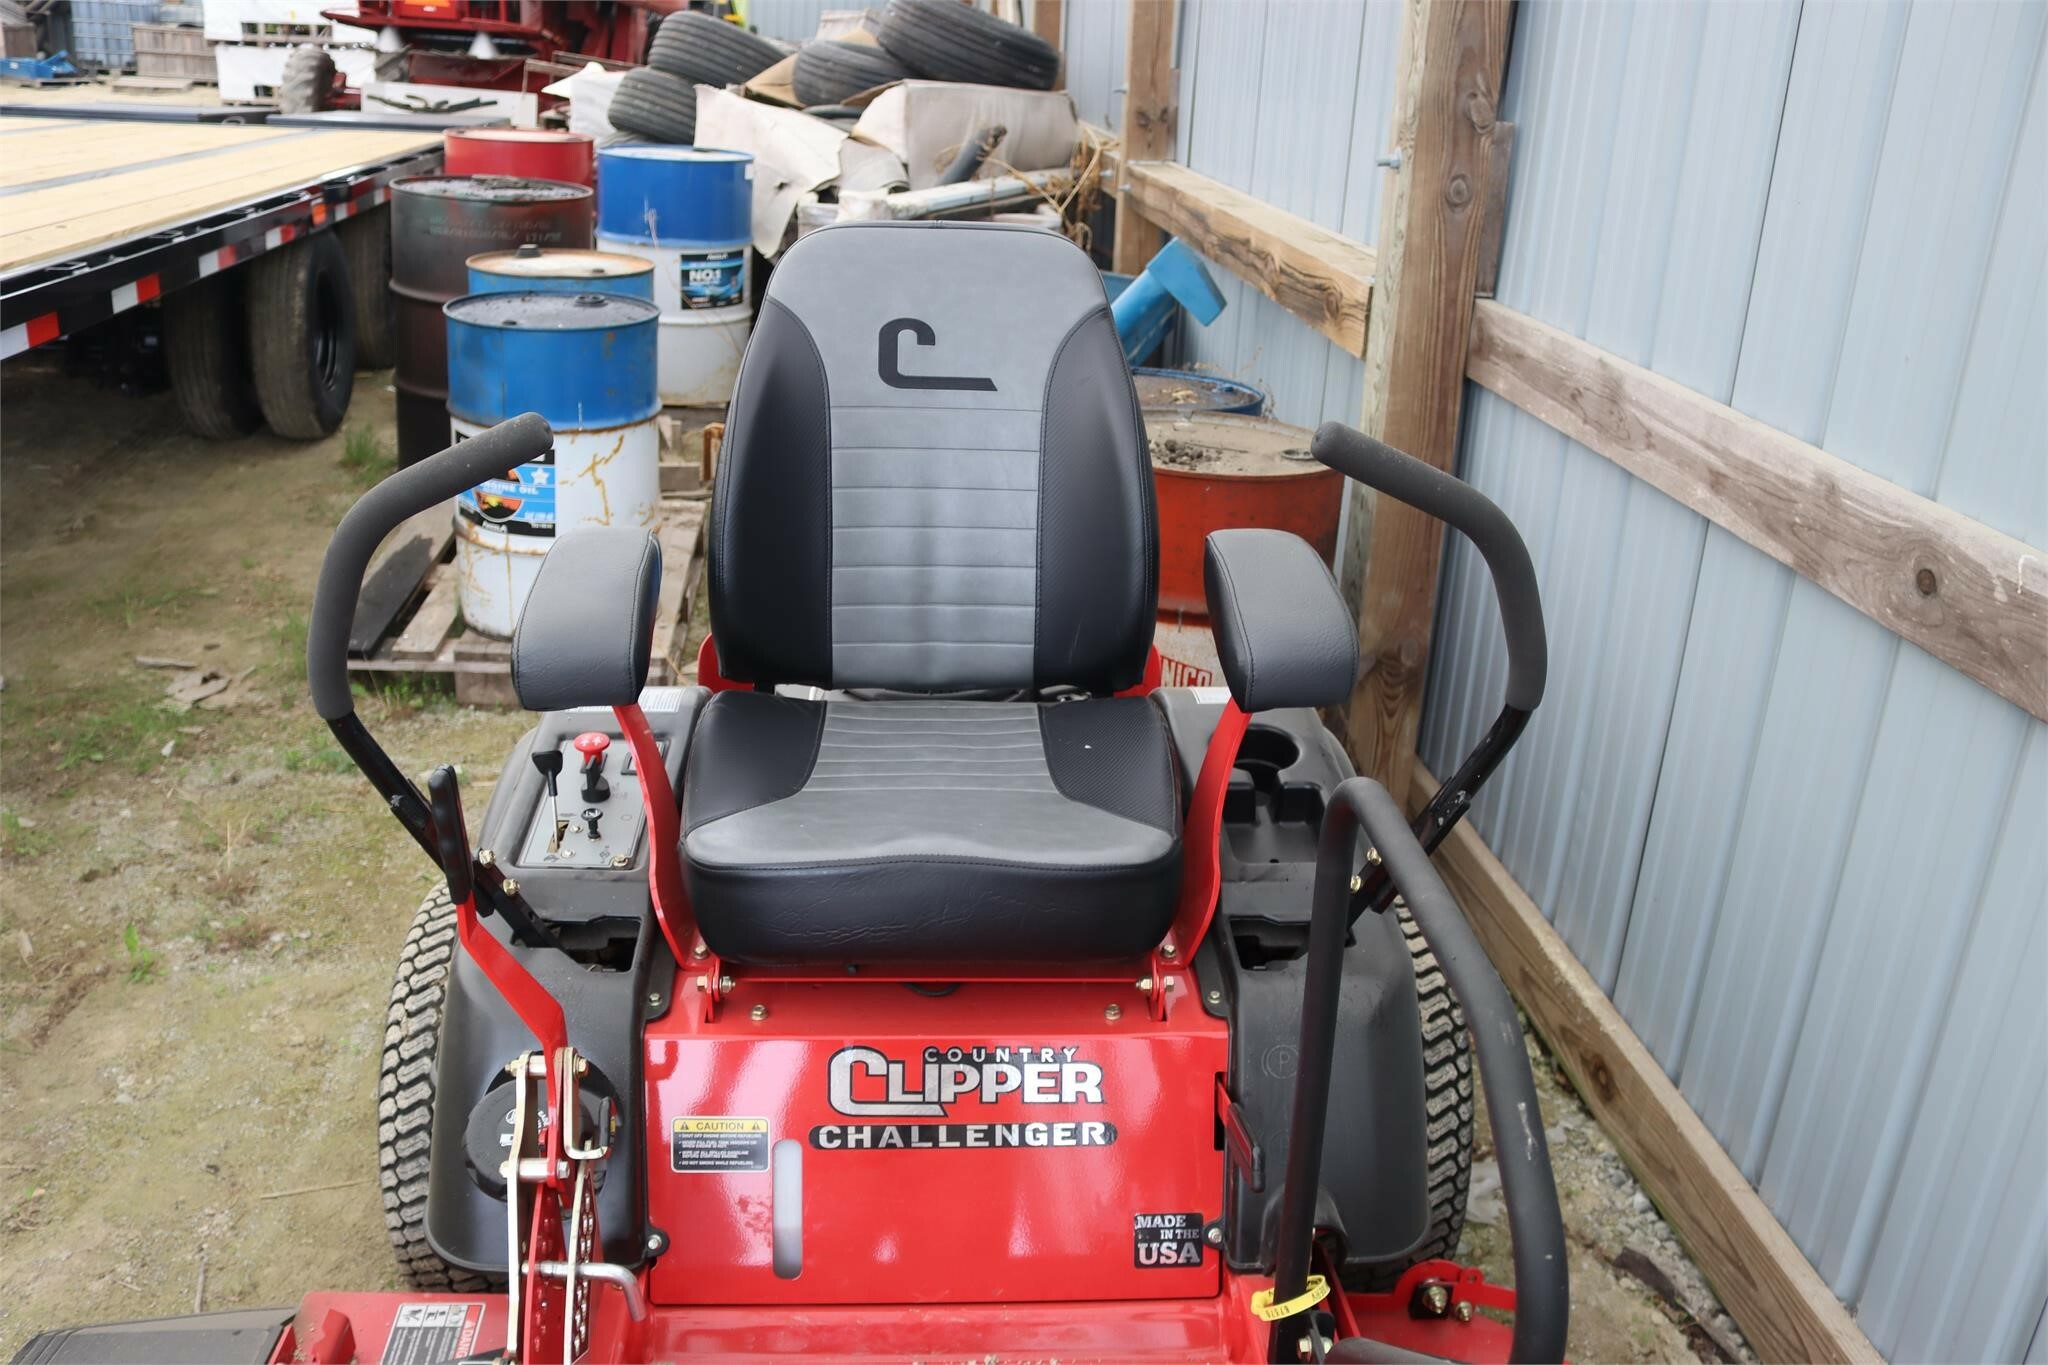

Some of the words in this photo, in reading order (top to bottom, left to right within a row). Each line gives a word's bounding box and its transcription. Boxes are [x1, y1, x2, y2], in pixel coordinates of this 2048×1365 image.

[521, 485, 538, 495] OIL
[924, 1047, 1078, 1062] COUNTRY
[828, 1046, 1104, 1117] CLIPPER
[696, 1122, 744, 1130] CAUTION
[818, 1122, 1105, 1149] CHALLENGER
[1136, 1214, 1186, 1228] MADE
[1160, 1229, 1173, 1239] IN
[1175, 1229, 1199, 1239] THE
[1137, 1241, 1200, 1265] USA
